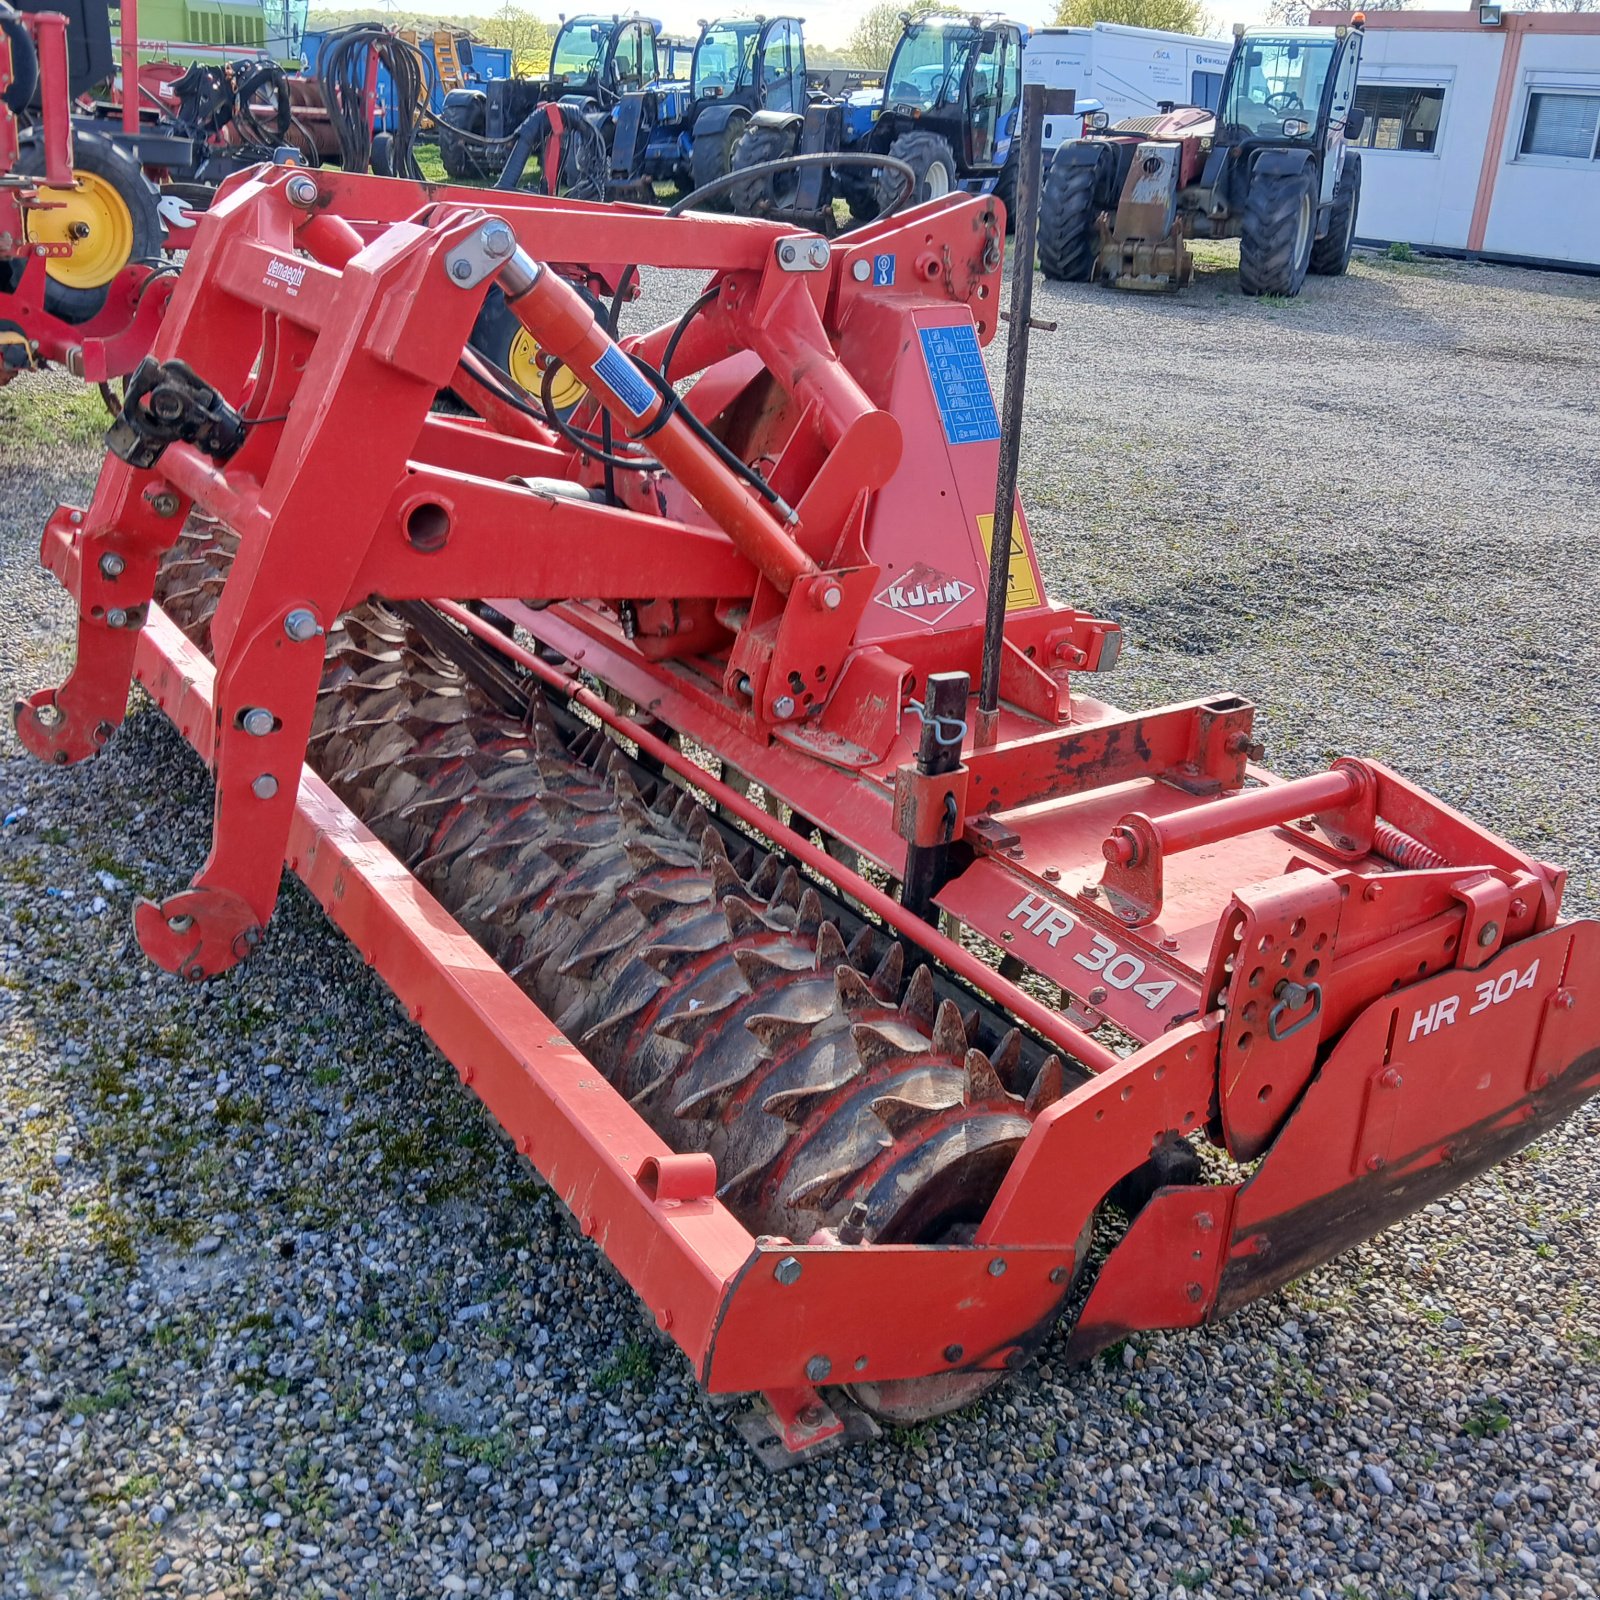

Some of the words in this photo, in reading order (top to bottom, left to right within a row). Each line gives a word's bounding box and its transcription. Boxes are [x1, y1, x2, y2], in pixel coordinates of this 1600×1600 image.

[267, 256, 307, 286] demaeght
[888, 580, 963, 609] KUHN
[1007, 893, 1075, 948] HR
[1072, 935, 1178, 1011] 304
[1408, 995, 1460, 1043] HR
[1469, 958, 1541, 1016] 304
